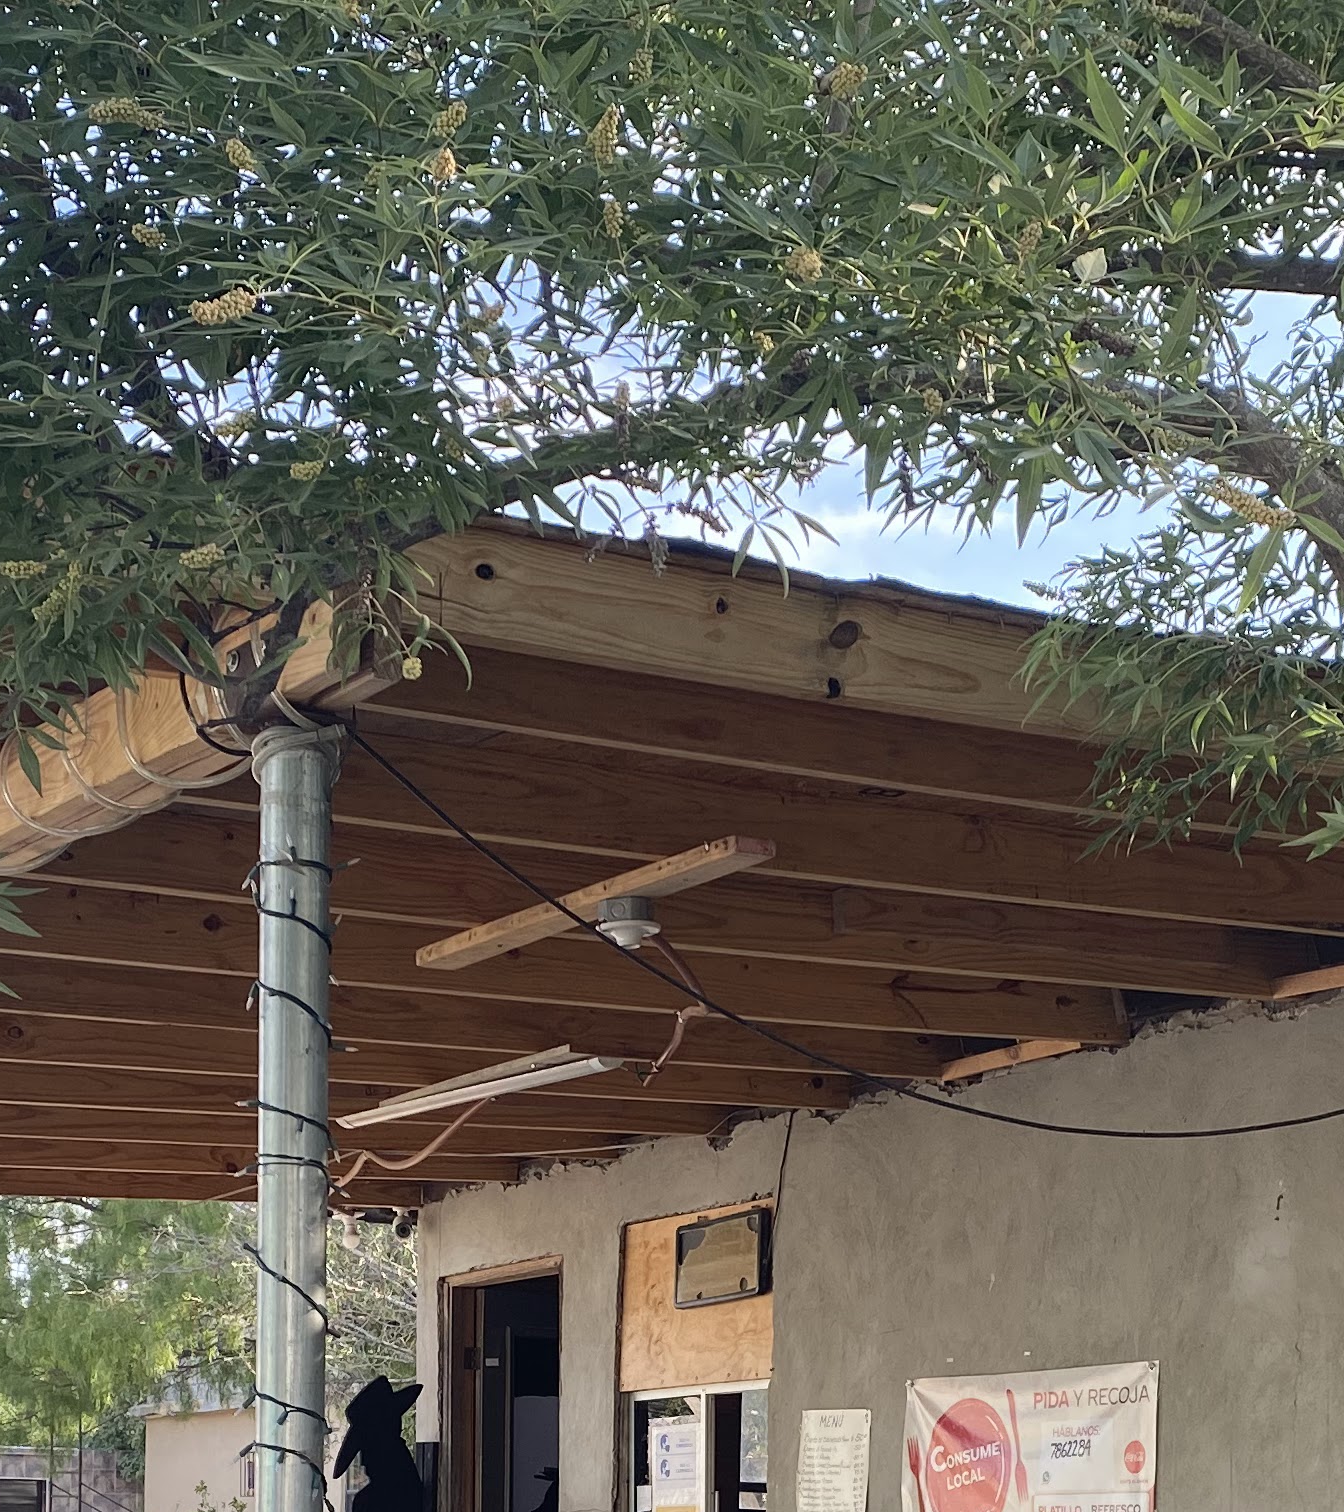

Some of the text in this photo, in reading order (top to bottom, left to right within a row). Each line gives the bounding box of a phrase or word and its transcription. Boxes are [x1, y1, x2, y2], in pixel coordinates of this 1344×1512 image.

[1033, 1385, 1151, 1410] PIDA Y RECOJA
[930, 1441, 1001, 1473] CONSUME
[946, 1467, 985, 1491] LOCAL
